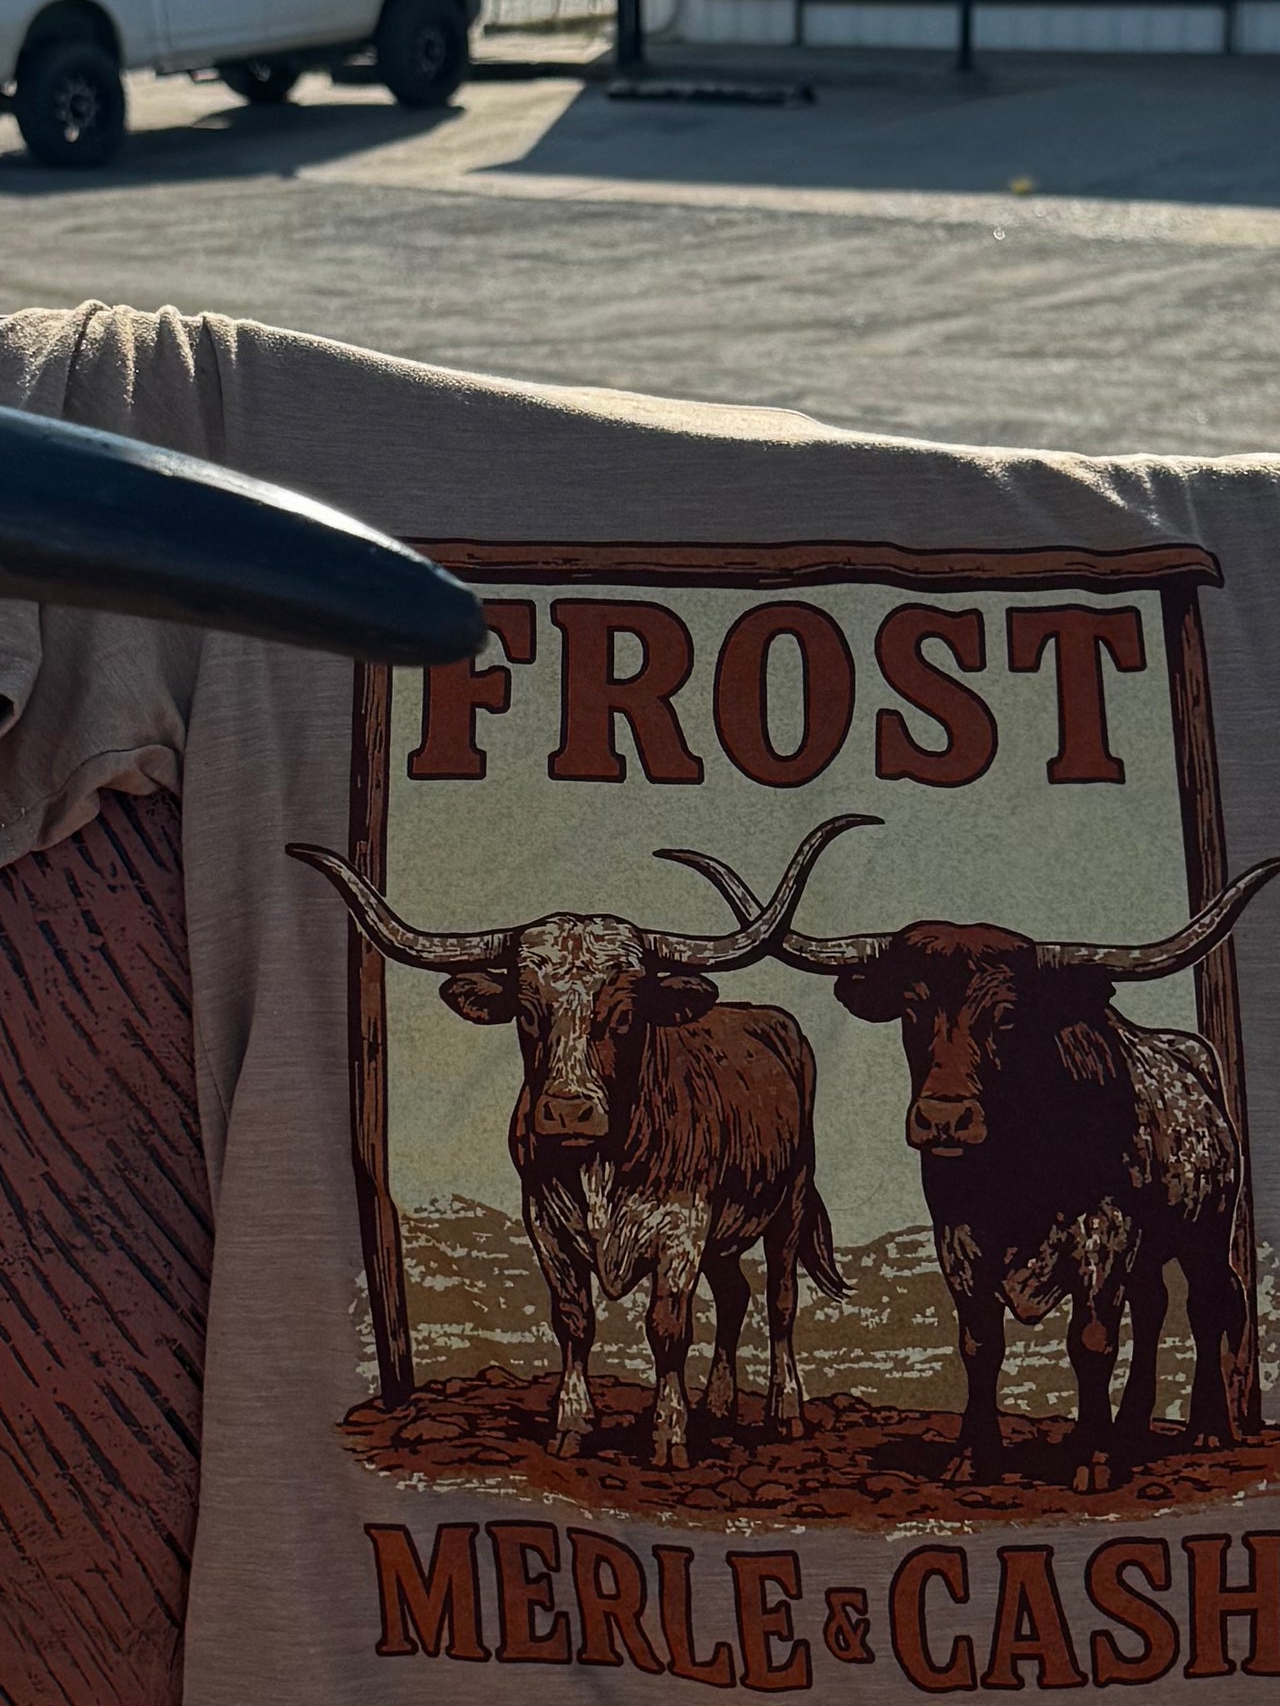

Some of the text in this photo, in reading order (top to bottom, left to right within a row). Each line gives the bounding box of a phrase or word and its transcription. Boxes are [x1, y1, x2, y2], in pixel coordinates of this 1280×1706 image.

[405, 597, 1147, 789] FROST
[363, 1520, 814, 1694] MERLE
[823, 1585, 874, 1665] &
